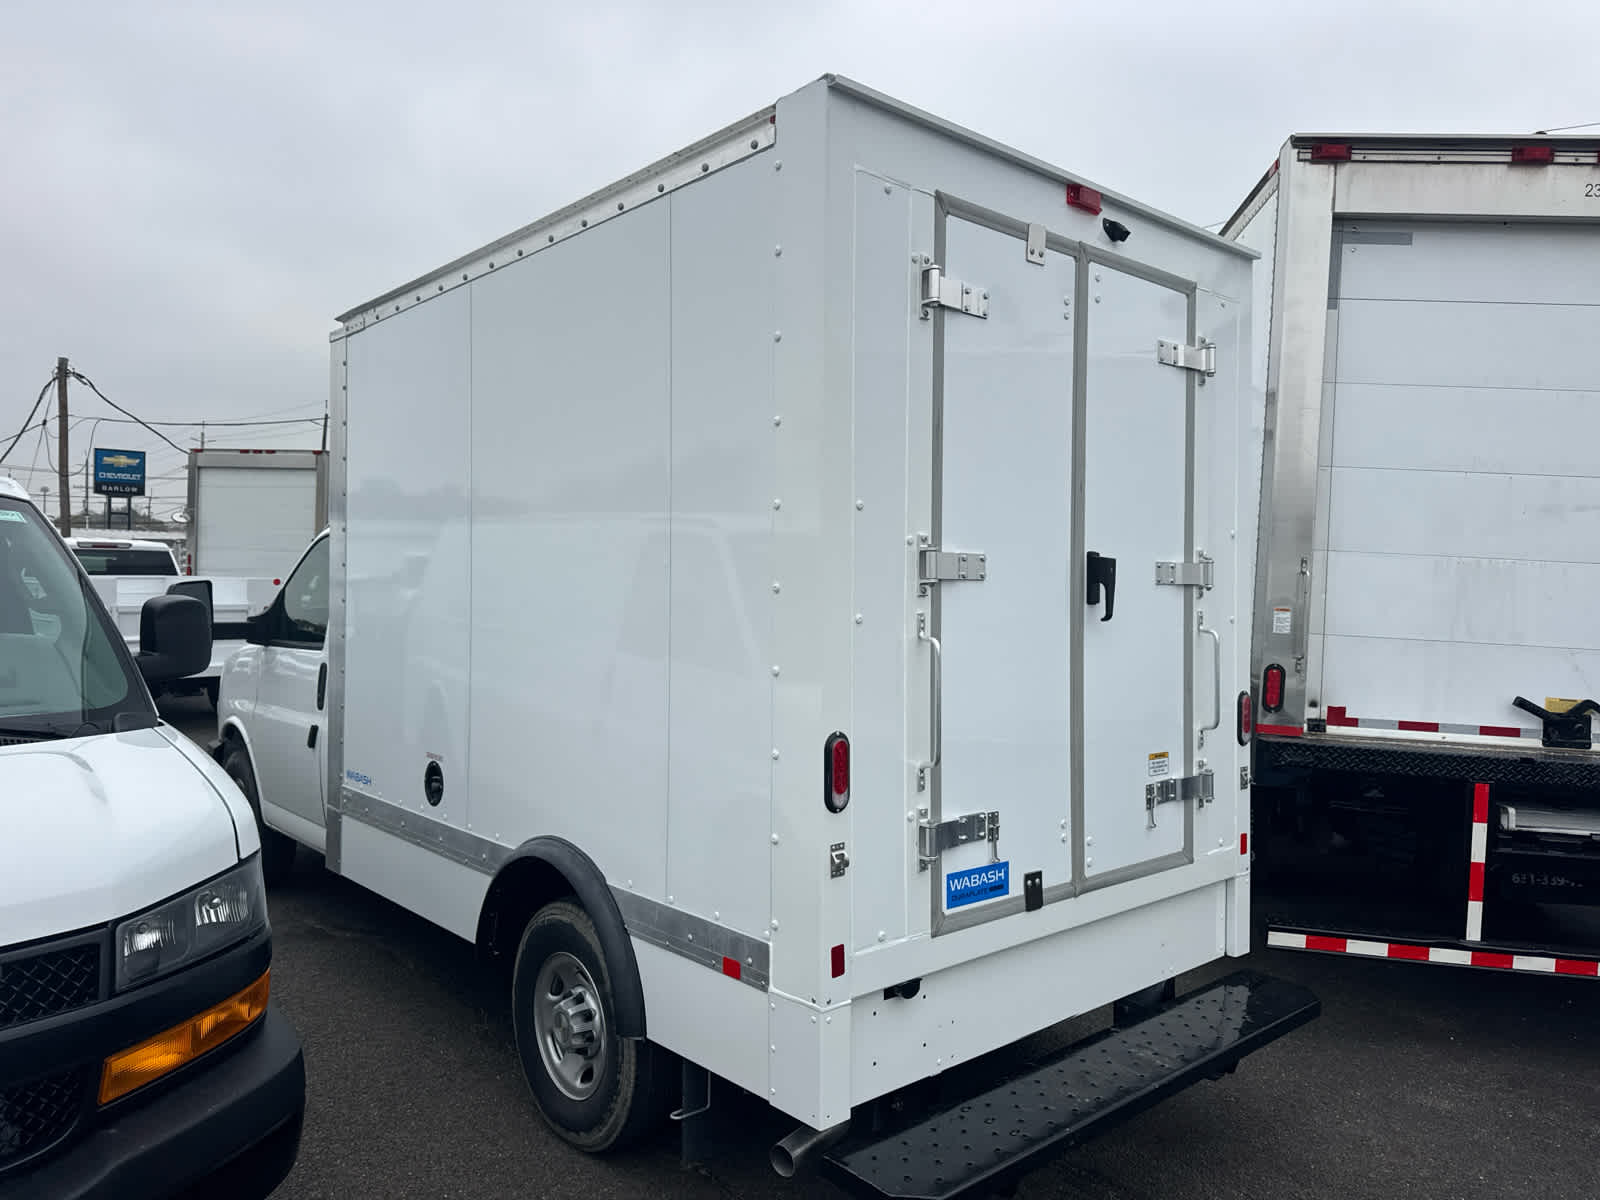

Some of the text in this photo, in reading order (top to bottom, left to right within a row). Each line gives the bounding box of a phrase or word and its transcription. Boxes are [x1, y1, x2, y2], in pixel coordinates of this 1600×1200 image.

[98, 471, 141, 481] CHEVROLET
[102, 484, 138, 493] BARLOW
[949, 868, 1005, 892] WABASH
